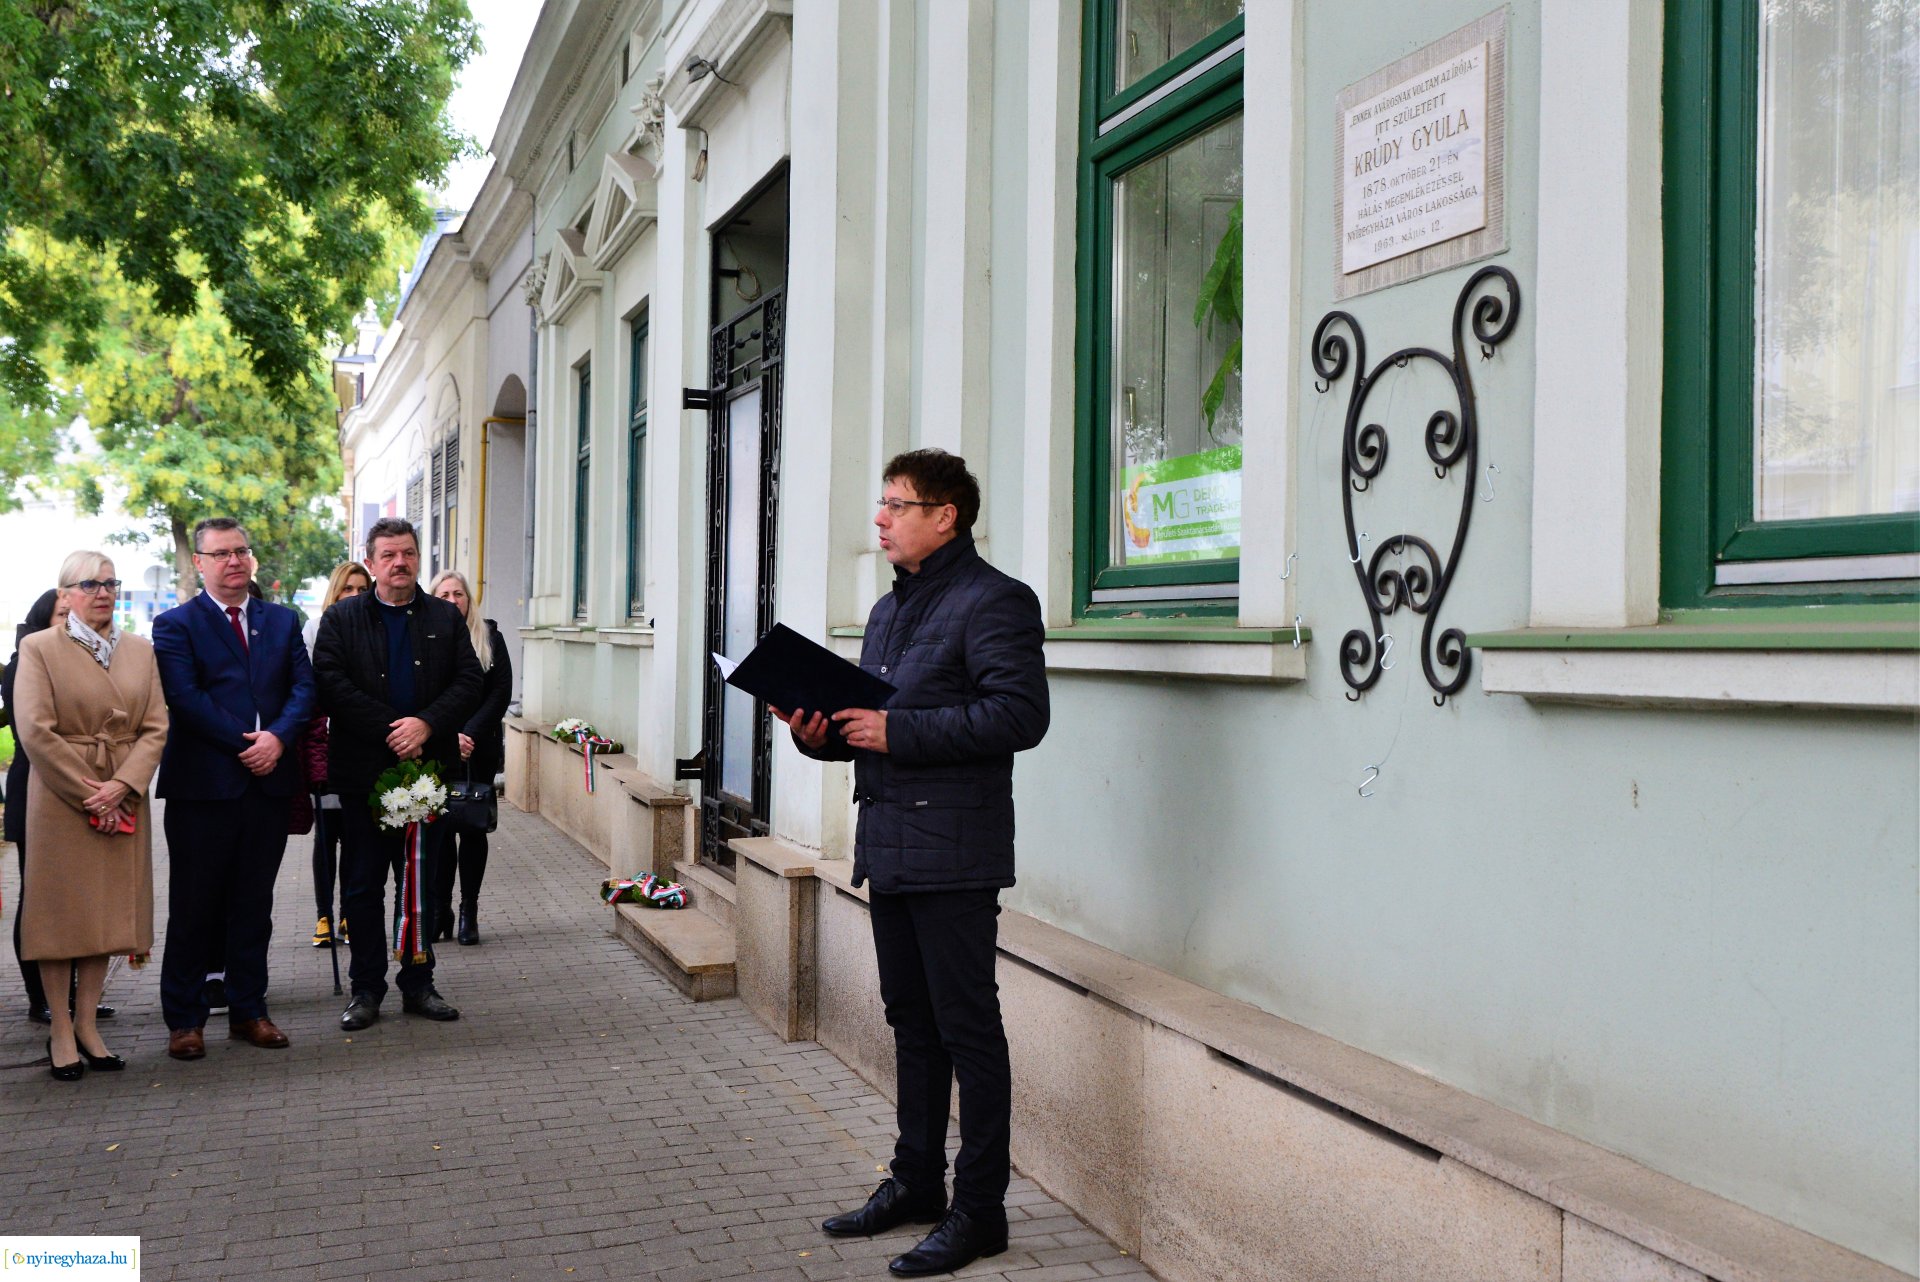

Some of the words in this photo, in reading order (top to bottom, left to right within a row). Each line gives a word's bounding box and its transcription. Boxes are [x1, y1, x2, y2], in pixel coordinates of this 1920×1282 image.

[1412, 76, 1440, 97] VOLTAM
[1375, 119, 1390, 136] ITT
[1393, 93, 1446, 127] SZÜLETETT
[1354, 136, 1403, 177] KRÚDY
[1412, 108, 1469, 151] GYULA
[1358, 202, 1383, 220] HÁLÁS
[1384, 171, 1464, 210] MEGEMLÉKEZÉSSEL
[1363, 177, 1390, 199] 1878.
[1390, 165, 1427, 188] OKTÓBER
[1429, 151, 1459, 173] 21-ÉN
[1347, 215, 1395, 243] NYÍREGYHÁZA
[1396, 205, 1423, 224] VÁROS
[1425, 184, 1478, 213] LAKOSSÁGA
[1374, 236, 1398, 253] 1963.
[1401, 227, 1426, 244] MÁJUS
[1431, 219, 1444, 233] 12.
[1152, 489, 1190, 522] MG
